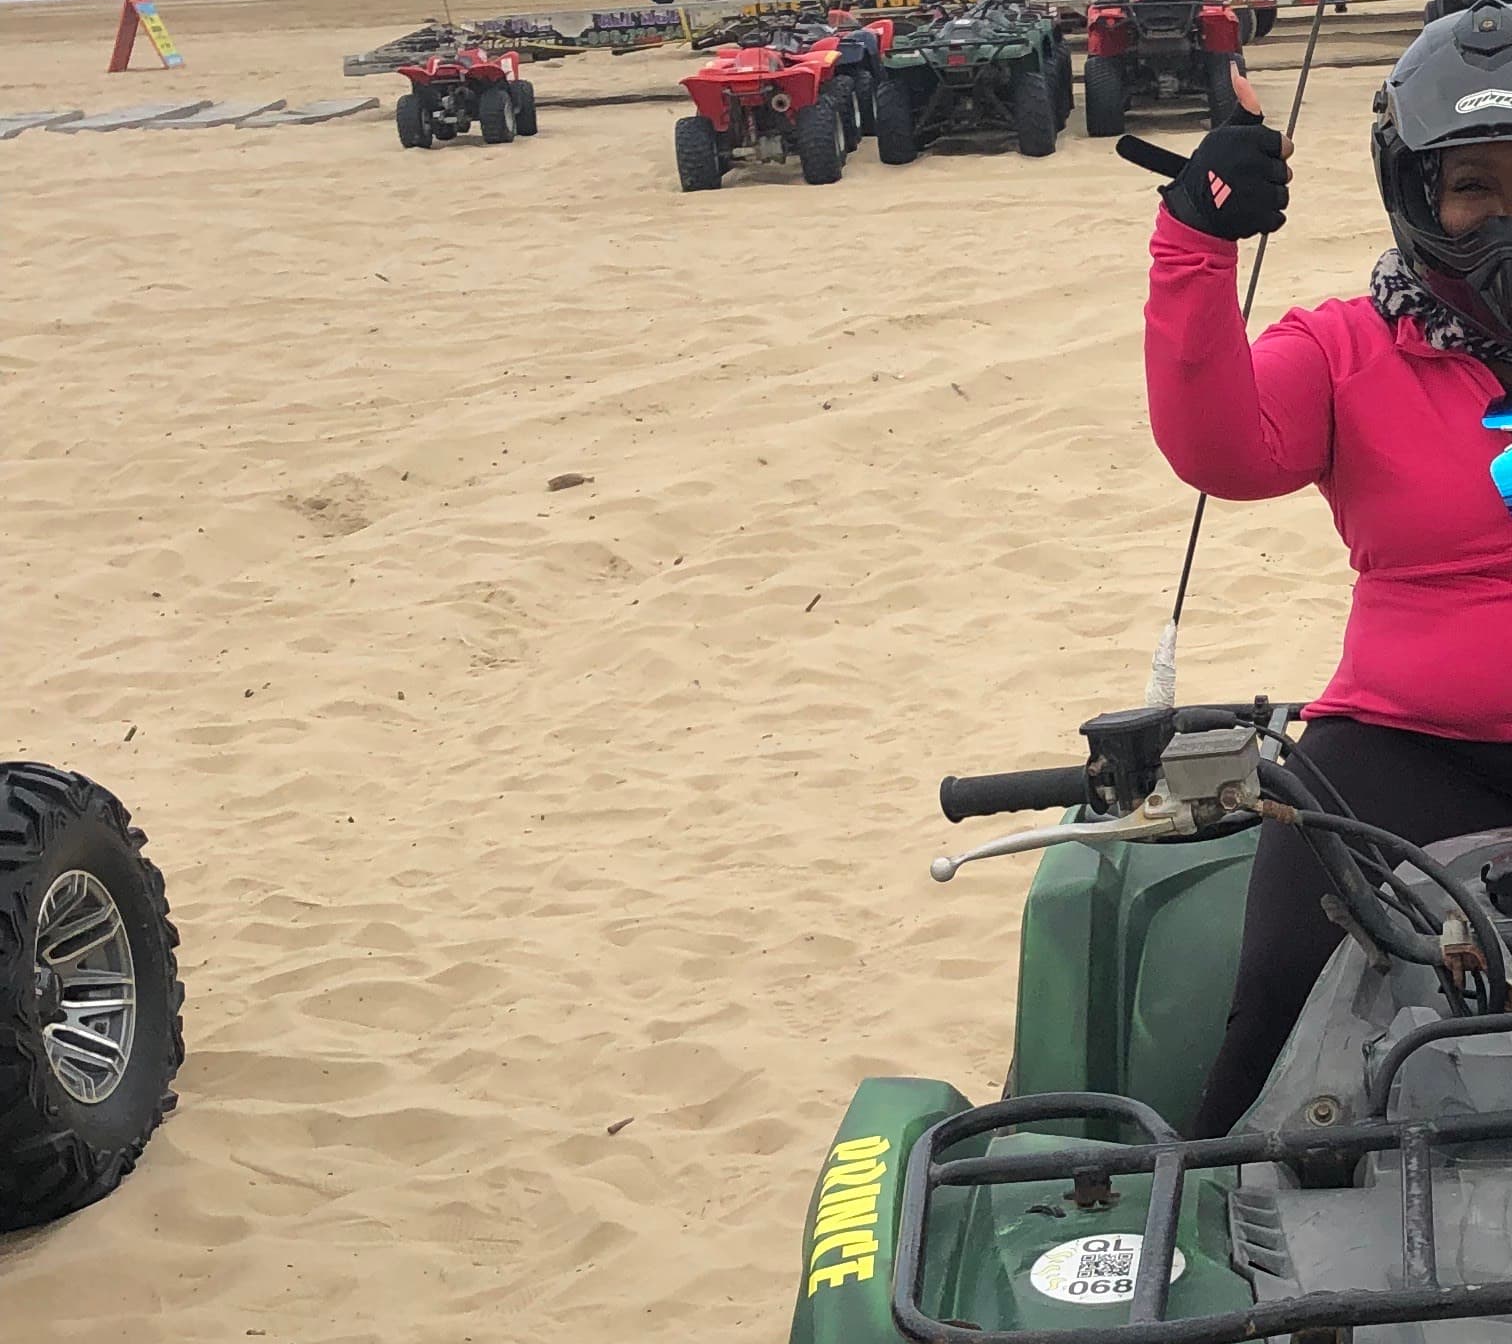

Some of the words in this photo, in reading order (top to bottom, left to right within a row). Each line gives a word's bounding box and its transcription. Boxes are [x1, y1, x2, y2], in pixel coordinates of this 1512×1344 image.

[808, 1135, 890, 1298] PRINCE
[1082, 1239, 1134, 1253] QL
[1068, 1278, 1133, 1296] 068
